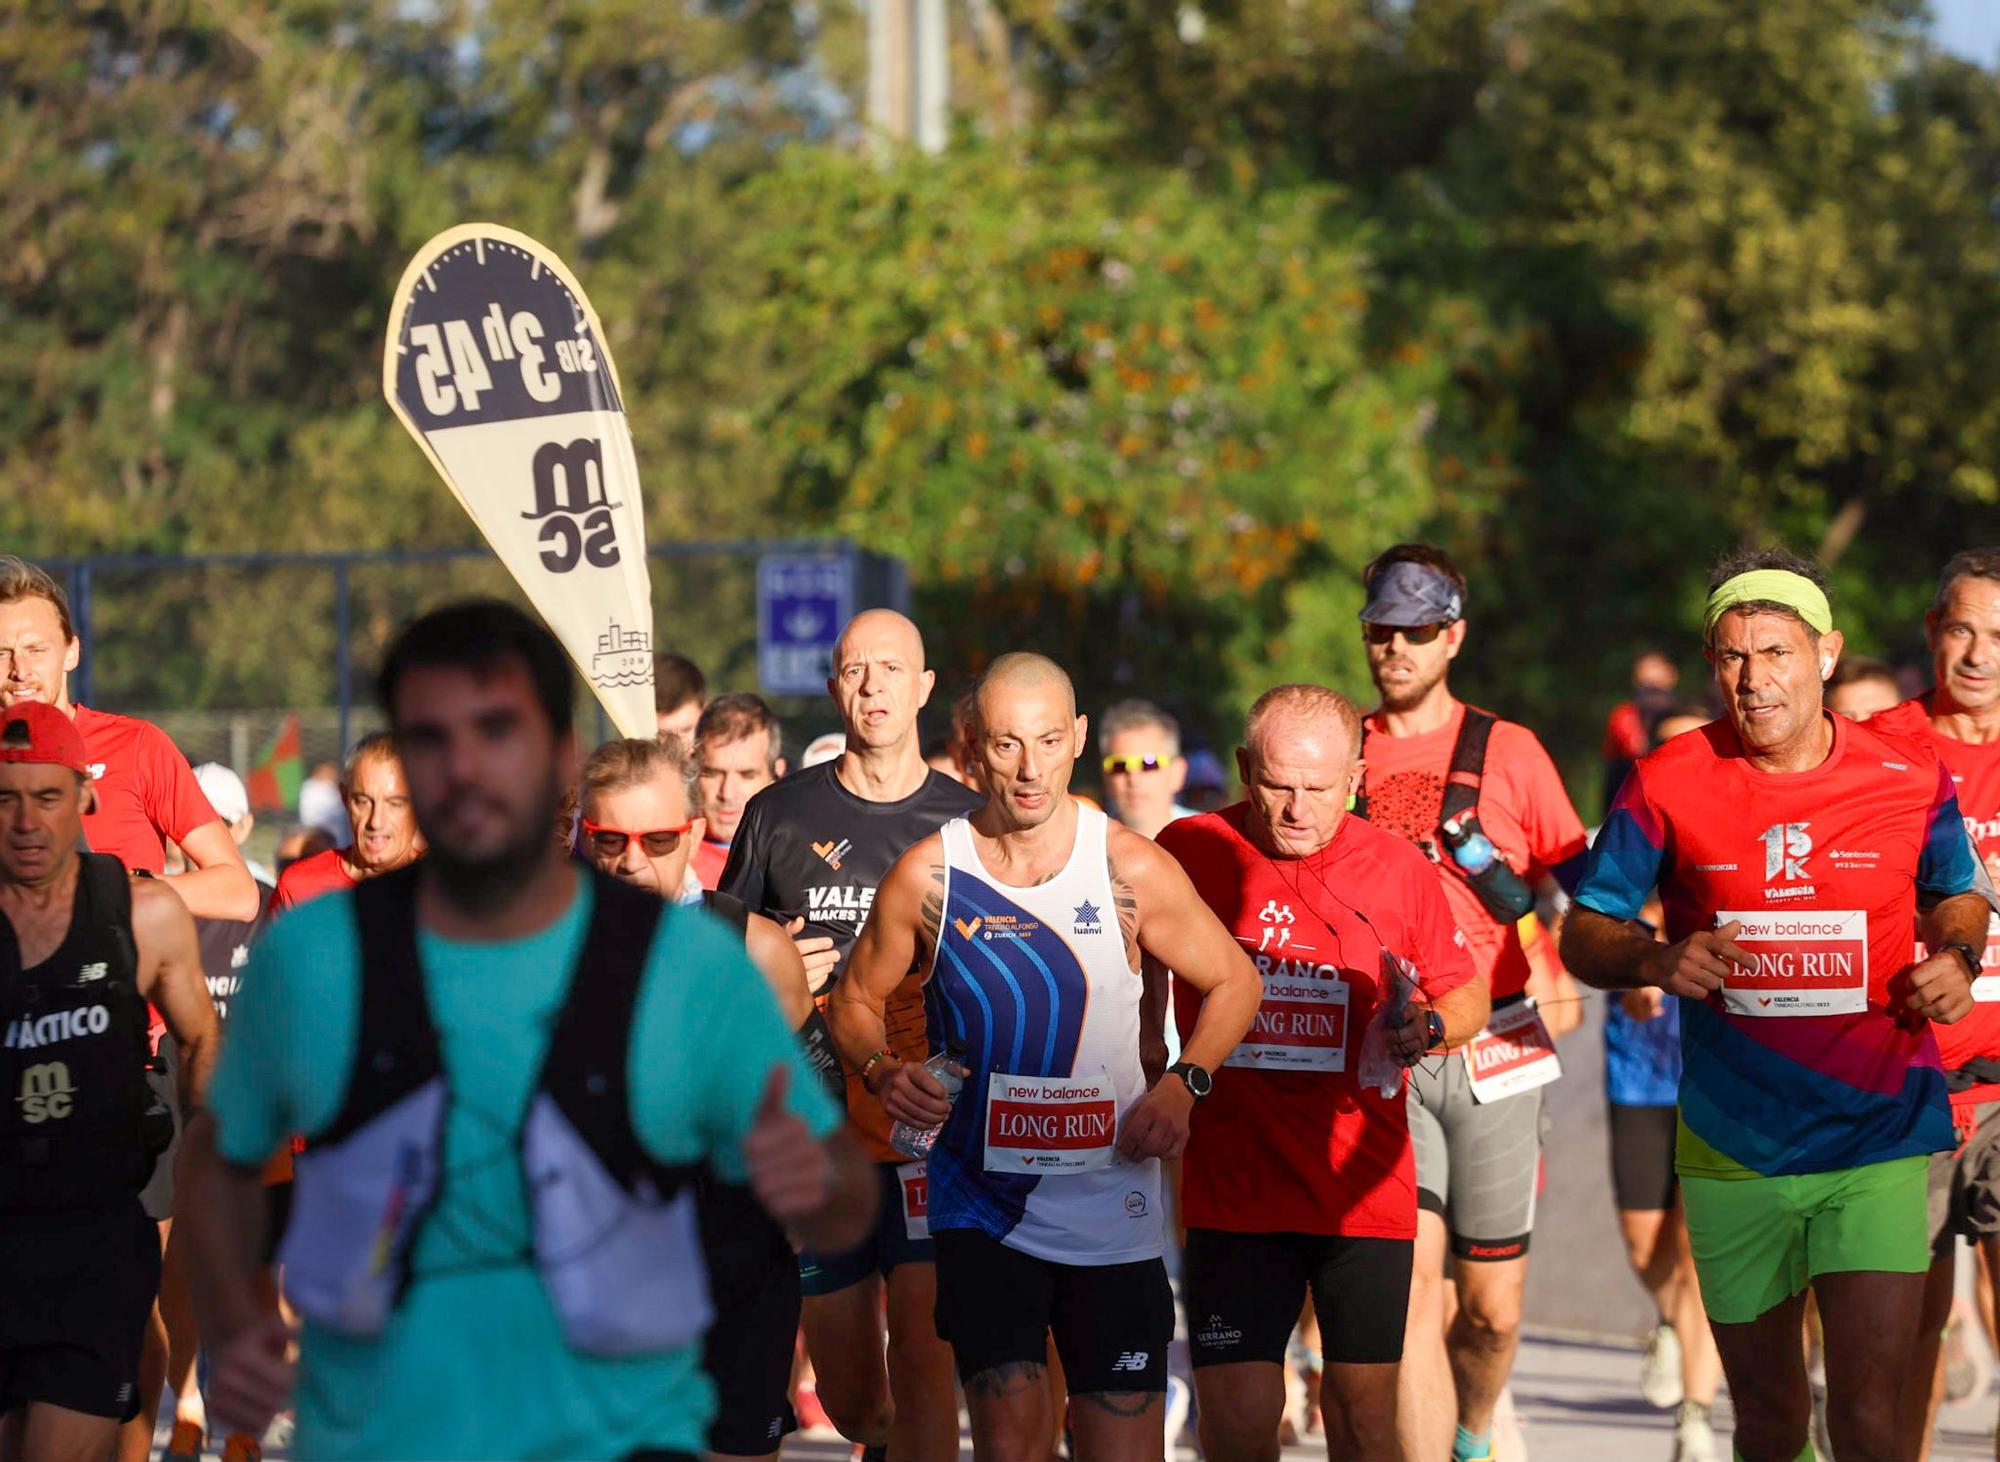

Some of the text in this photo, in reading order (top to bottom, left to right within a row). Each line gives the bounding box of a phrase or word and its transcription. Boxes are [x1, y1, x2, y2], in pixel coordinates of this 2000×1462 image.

[808, 909, 857, 923] MAKES
[985, 916, 1017, 924] VALENCIA
[1074, 926, 1102, 935] luanvi
[1739, 922, 1843, 936] new balance
[1801, 953, 1853, 977] RUN
[1270, 983, 1329, 999] balance
[1291, 1012, 1337, 1037] RUN
[1475, 1040, 1521, 1072] LONG
[1008, 1086, 1100, 1099] new balance
[999, 1113, 1106, 1138] LONG RUN
